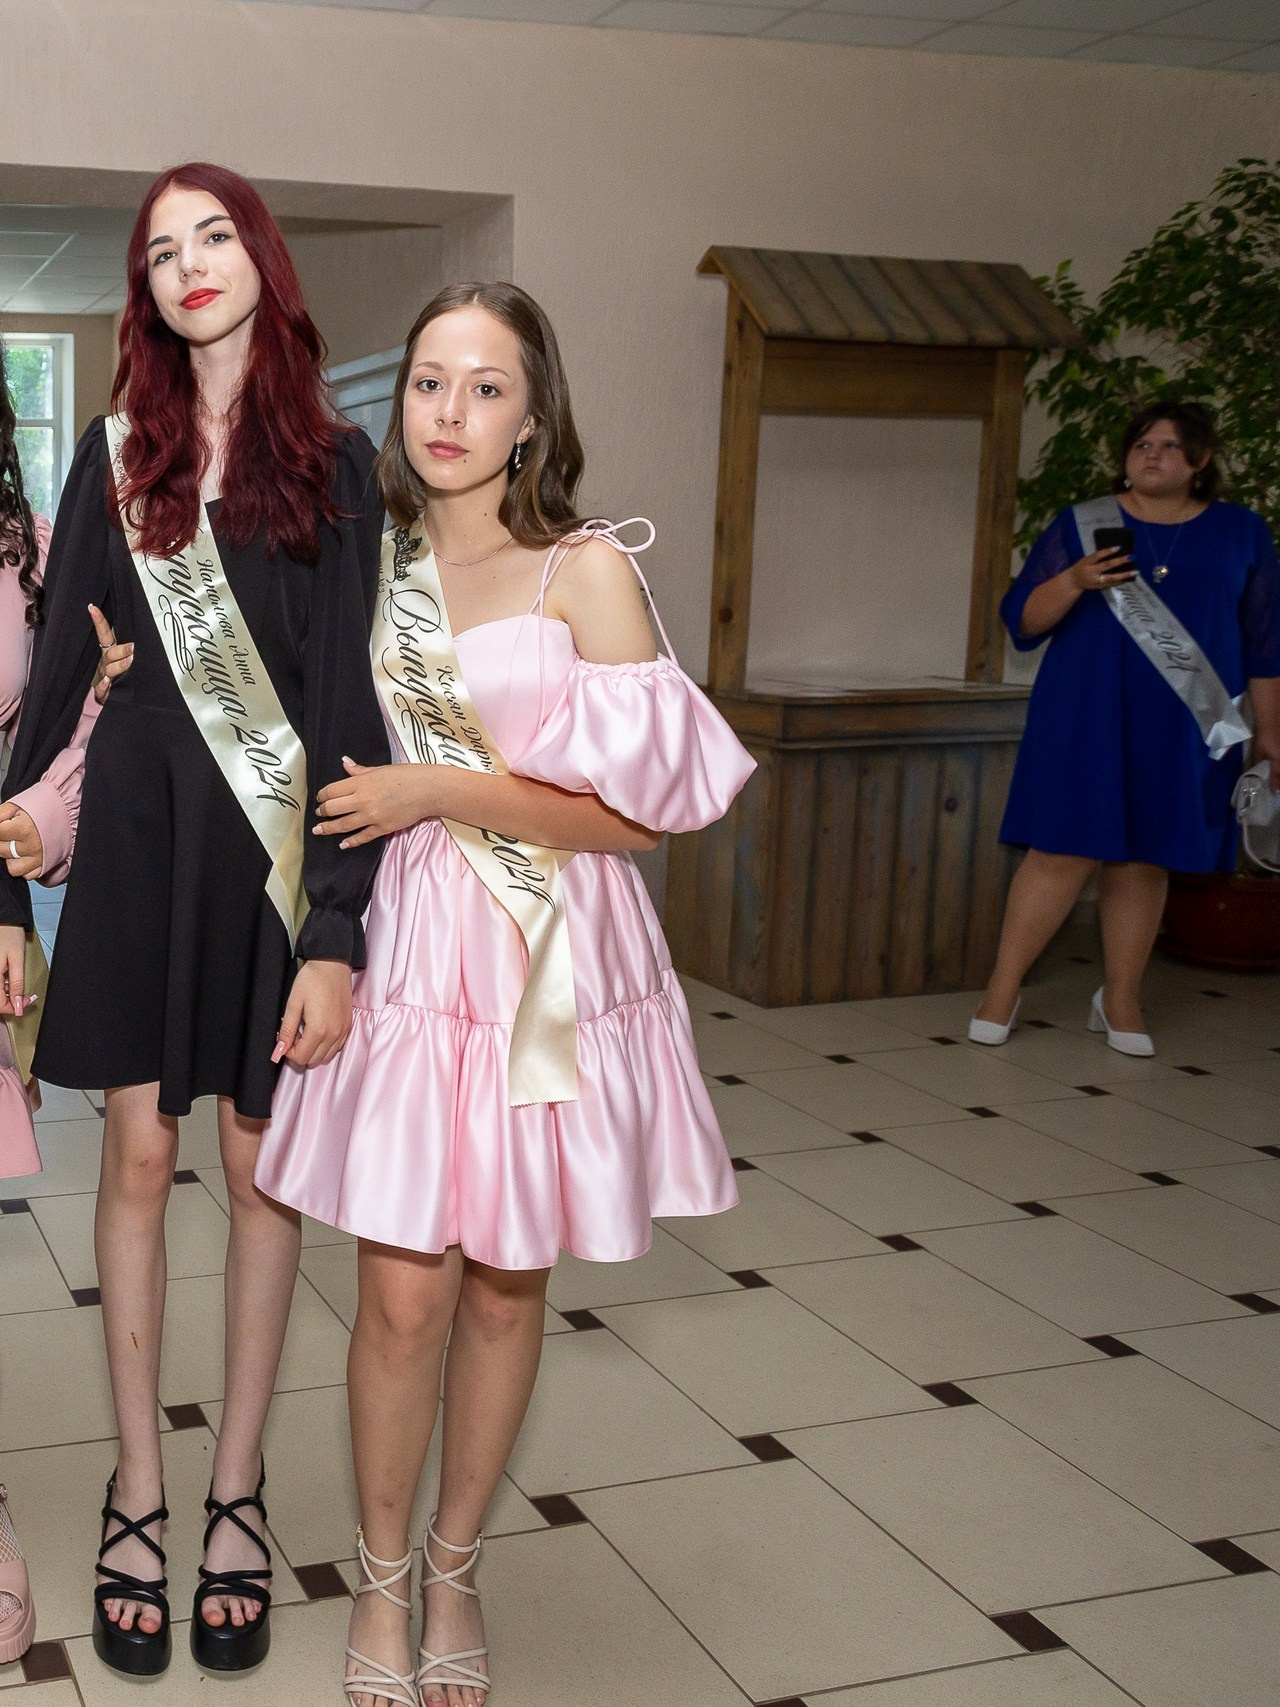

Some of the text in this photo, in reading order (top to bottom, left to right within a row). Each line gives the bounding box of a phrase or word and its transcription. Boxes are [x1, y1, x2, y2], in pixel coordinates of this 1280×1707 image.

[228, 645, 256, 685] Анна
[1146, 630, 1203, 673] 2024
[143, 551, 300, 812] пускница 2024
[436, 665, 465, 719] Косян
[381, 588, 556, 915] Выпускн 2024
